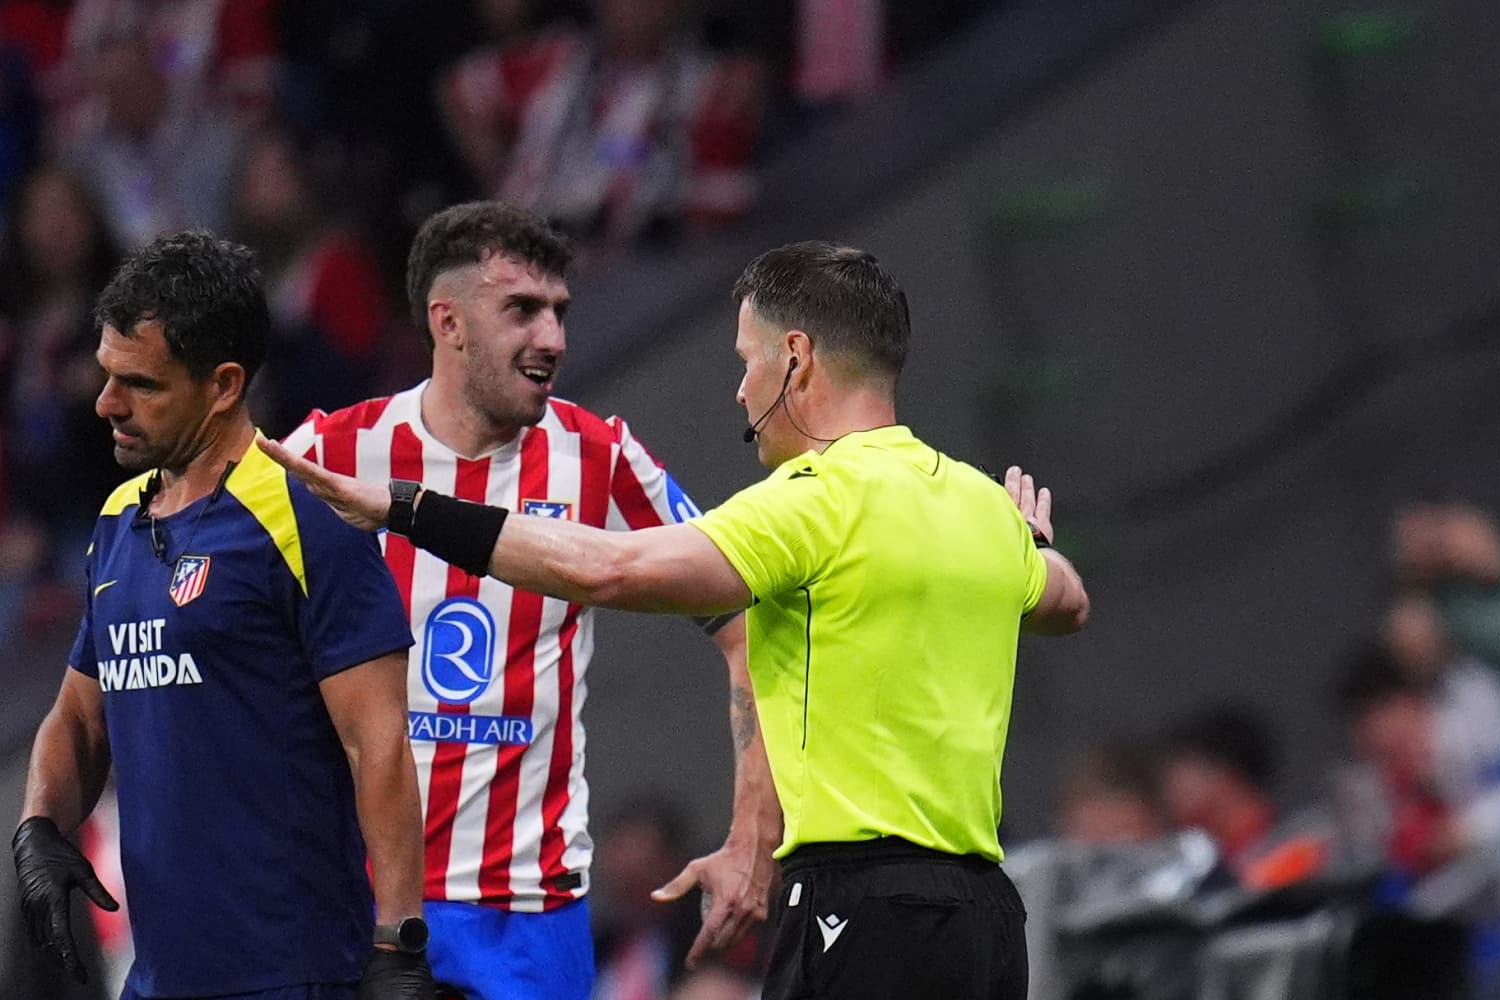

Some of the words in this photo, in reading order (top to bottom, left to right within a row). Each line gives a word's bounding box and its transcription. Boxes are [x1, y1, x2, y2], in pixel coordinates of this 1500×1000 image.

[108, 618, 166, 655] VISIT
[408, 715, 476, 741] YADH
[483, 719, 527, 742] AIR
